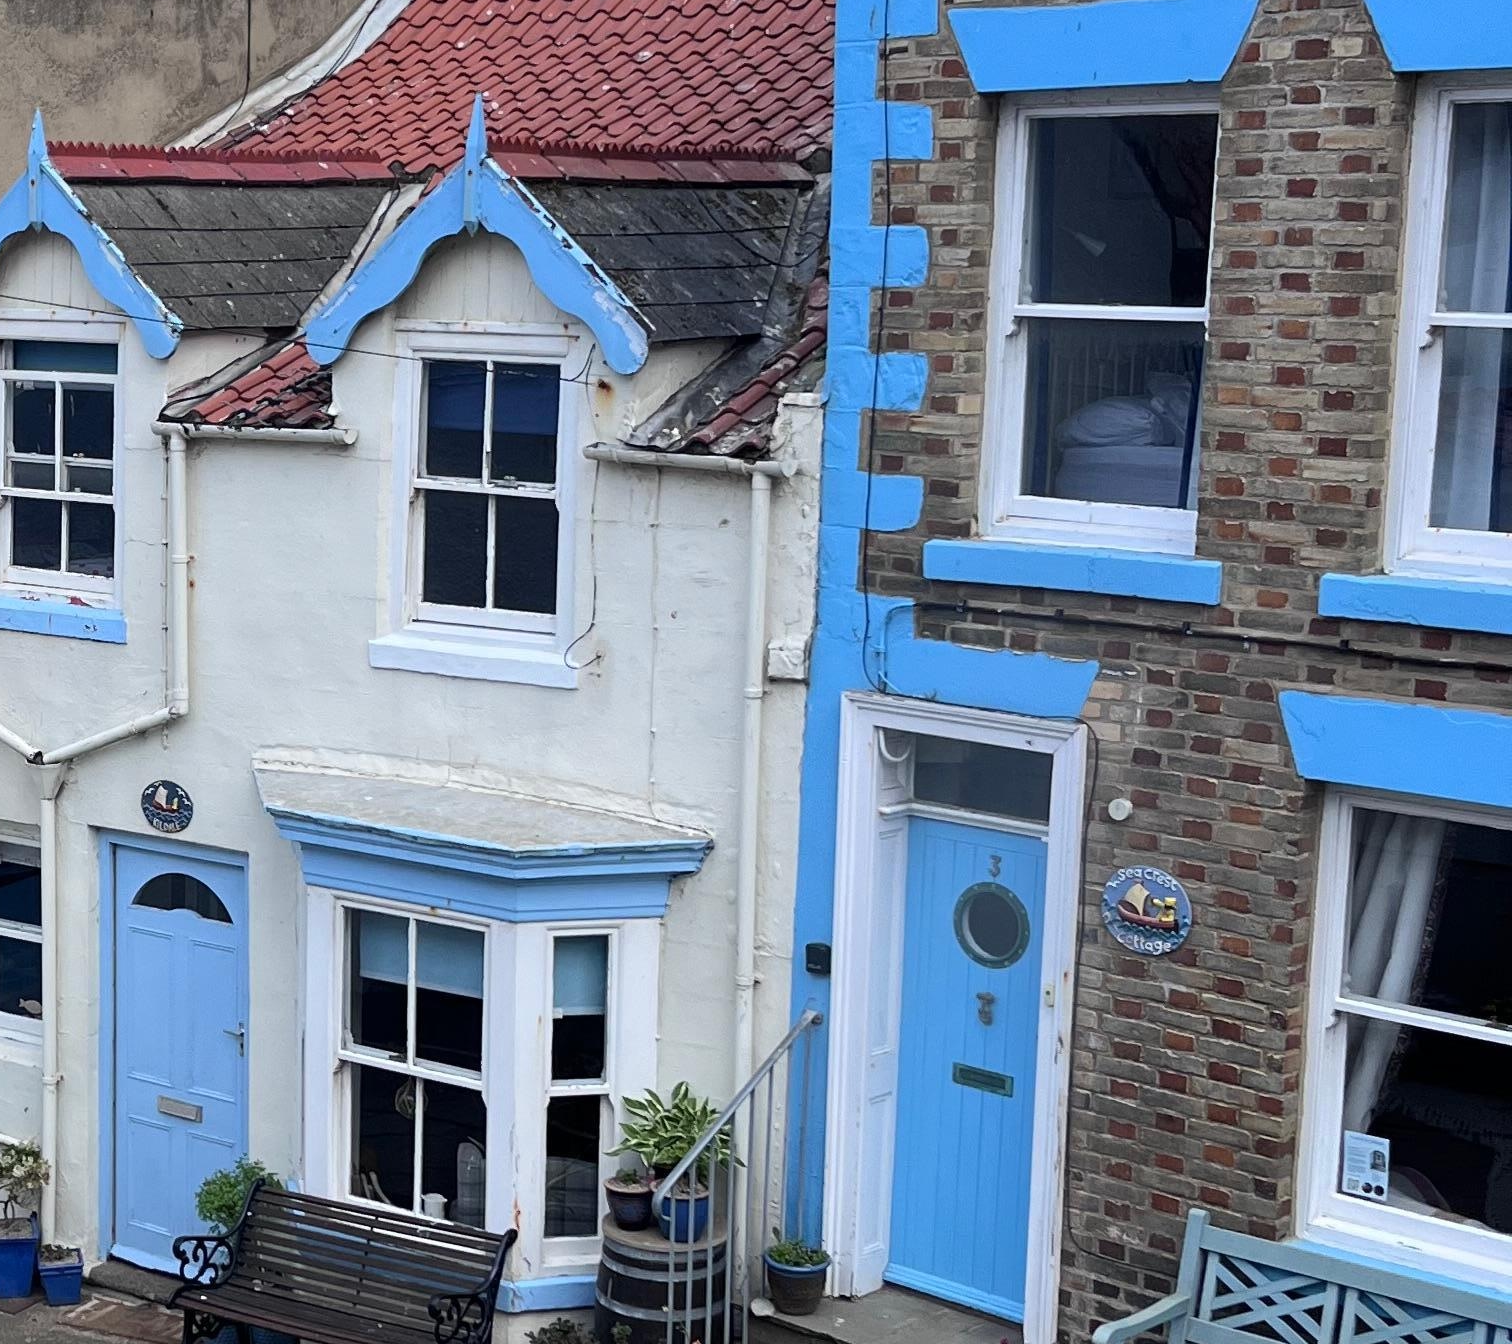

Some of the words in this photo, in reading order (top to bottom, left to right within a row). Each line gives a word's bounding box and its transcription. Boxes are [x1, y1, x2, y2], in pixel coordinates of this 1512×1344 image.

[988, 855, 1001, 877] 3
[1117, 869, 1143, 881] Sea
[1143, 868, 1178, 892] Crest
[1117, 933, 1172, 956] Cottage
